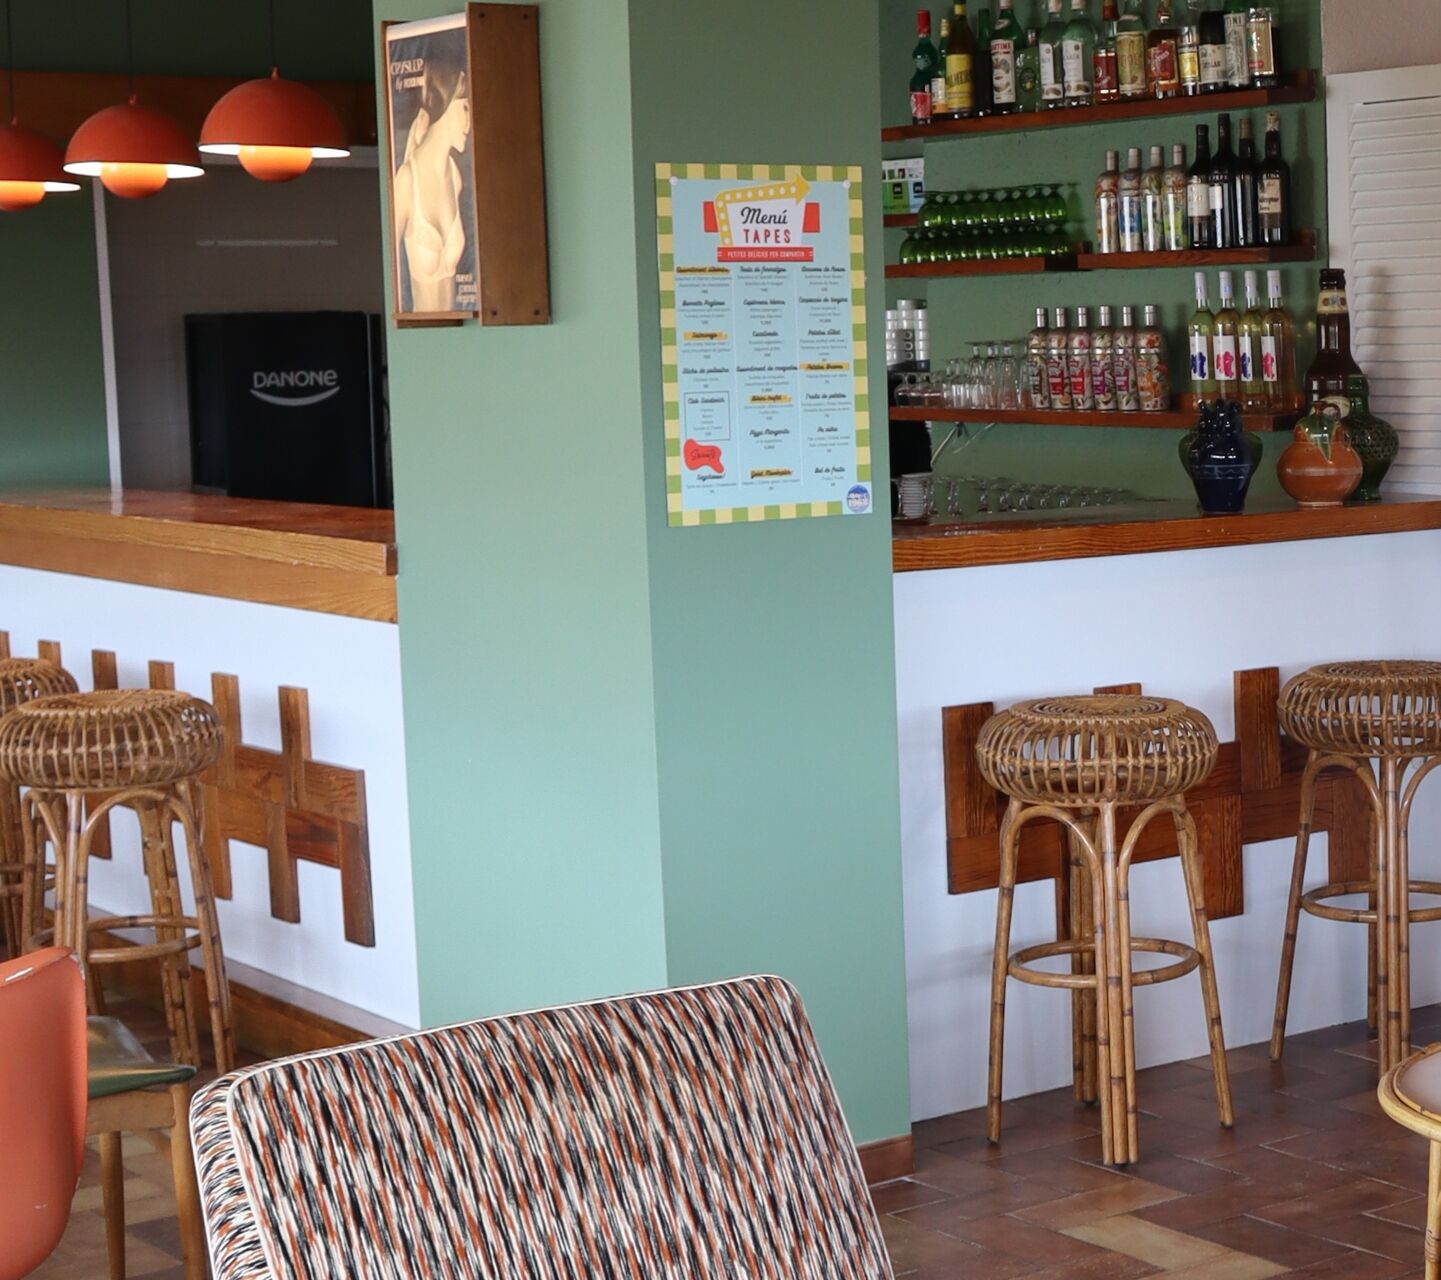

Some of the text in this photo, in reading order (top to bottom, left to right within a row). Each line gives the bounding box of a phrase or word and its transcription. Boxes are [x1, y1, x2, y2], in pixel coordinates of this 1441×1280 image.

[740, 206, 788, 225] Menú
[743, 228, 791, 244] TAPES
[253, 369, 338, 389] DANONE
